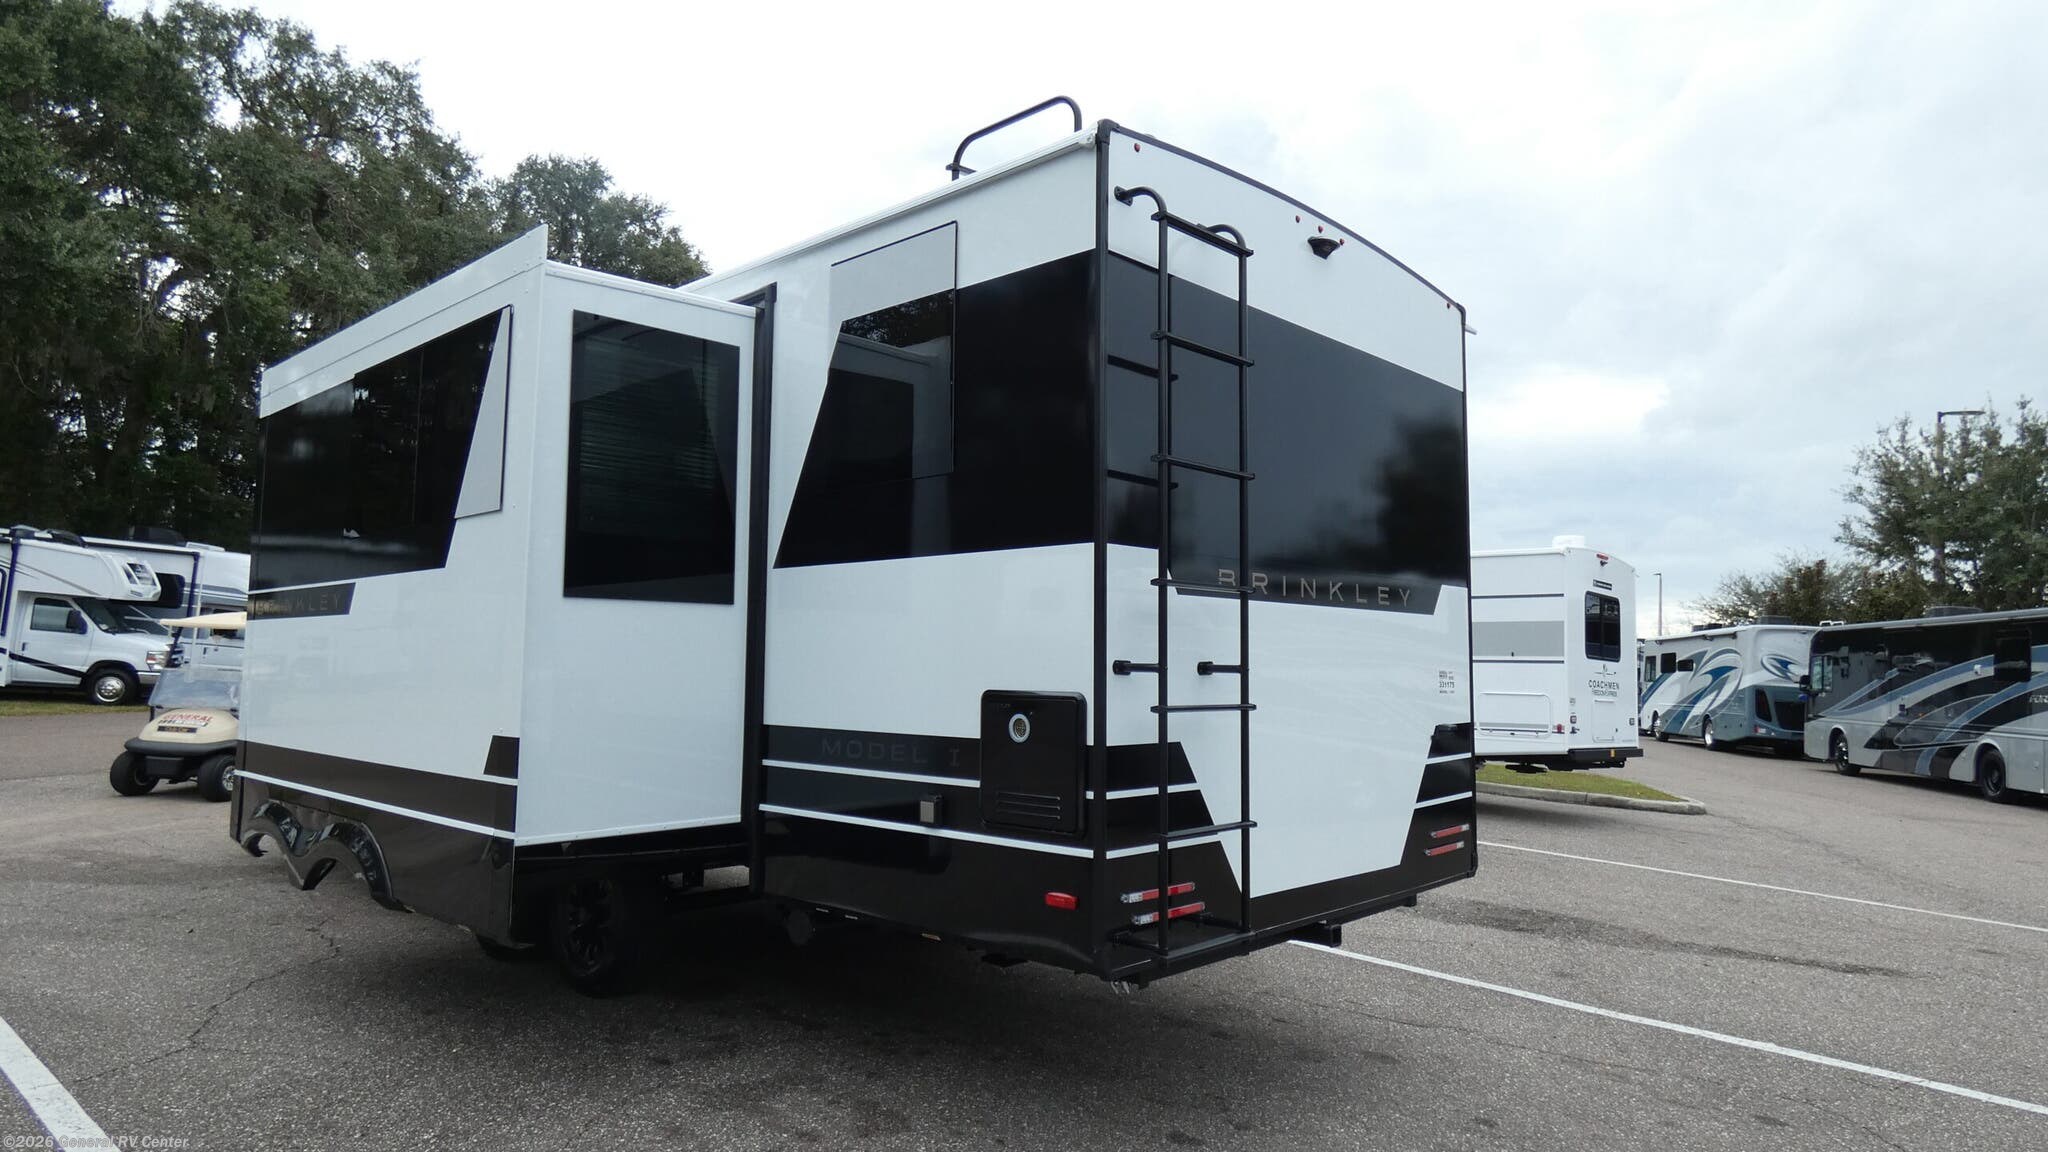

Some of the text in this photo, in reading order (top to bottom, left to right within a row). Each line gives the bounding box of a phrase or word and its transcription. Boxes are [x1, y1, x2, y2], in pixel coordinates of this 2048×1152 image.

[1217, 567, 1411, 607] BRINKLEY
[1588, 679, 1620, 690] COACHMEN
[163, 713, 213, 722] GENERAL
[821, 738, 929, 764] MODEL
